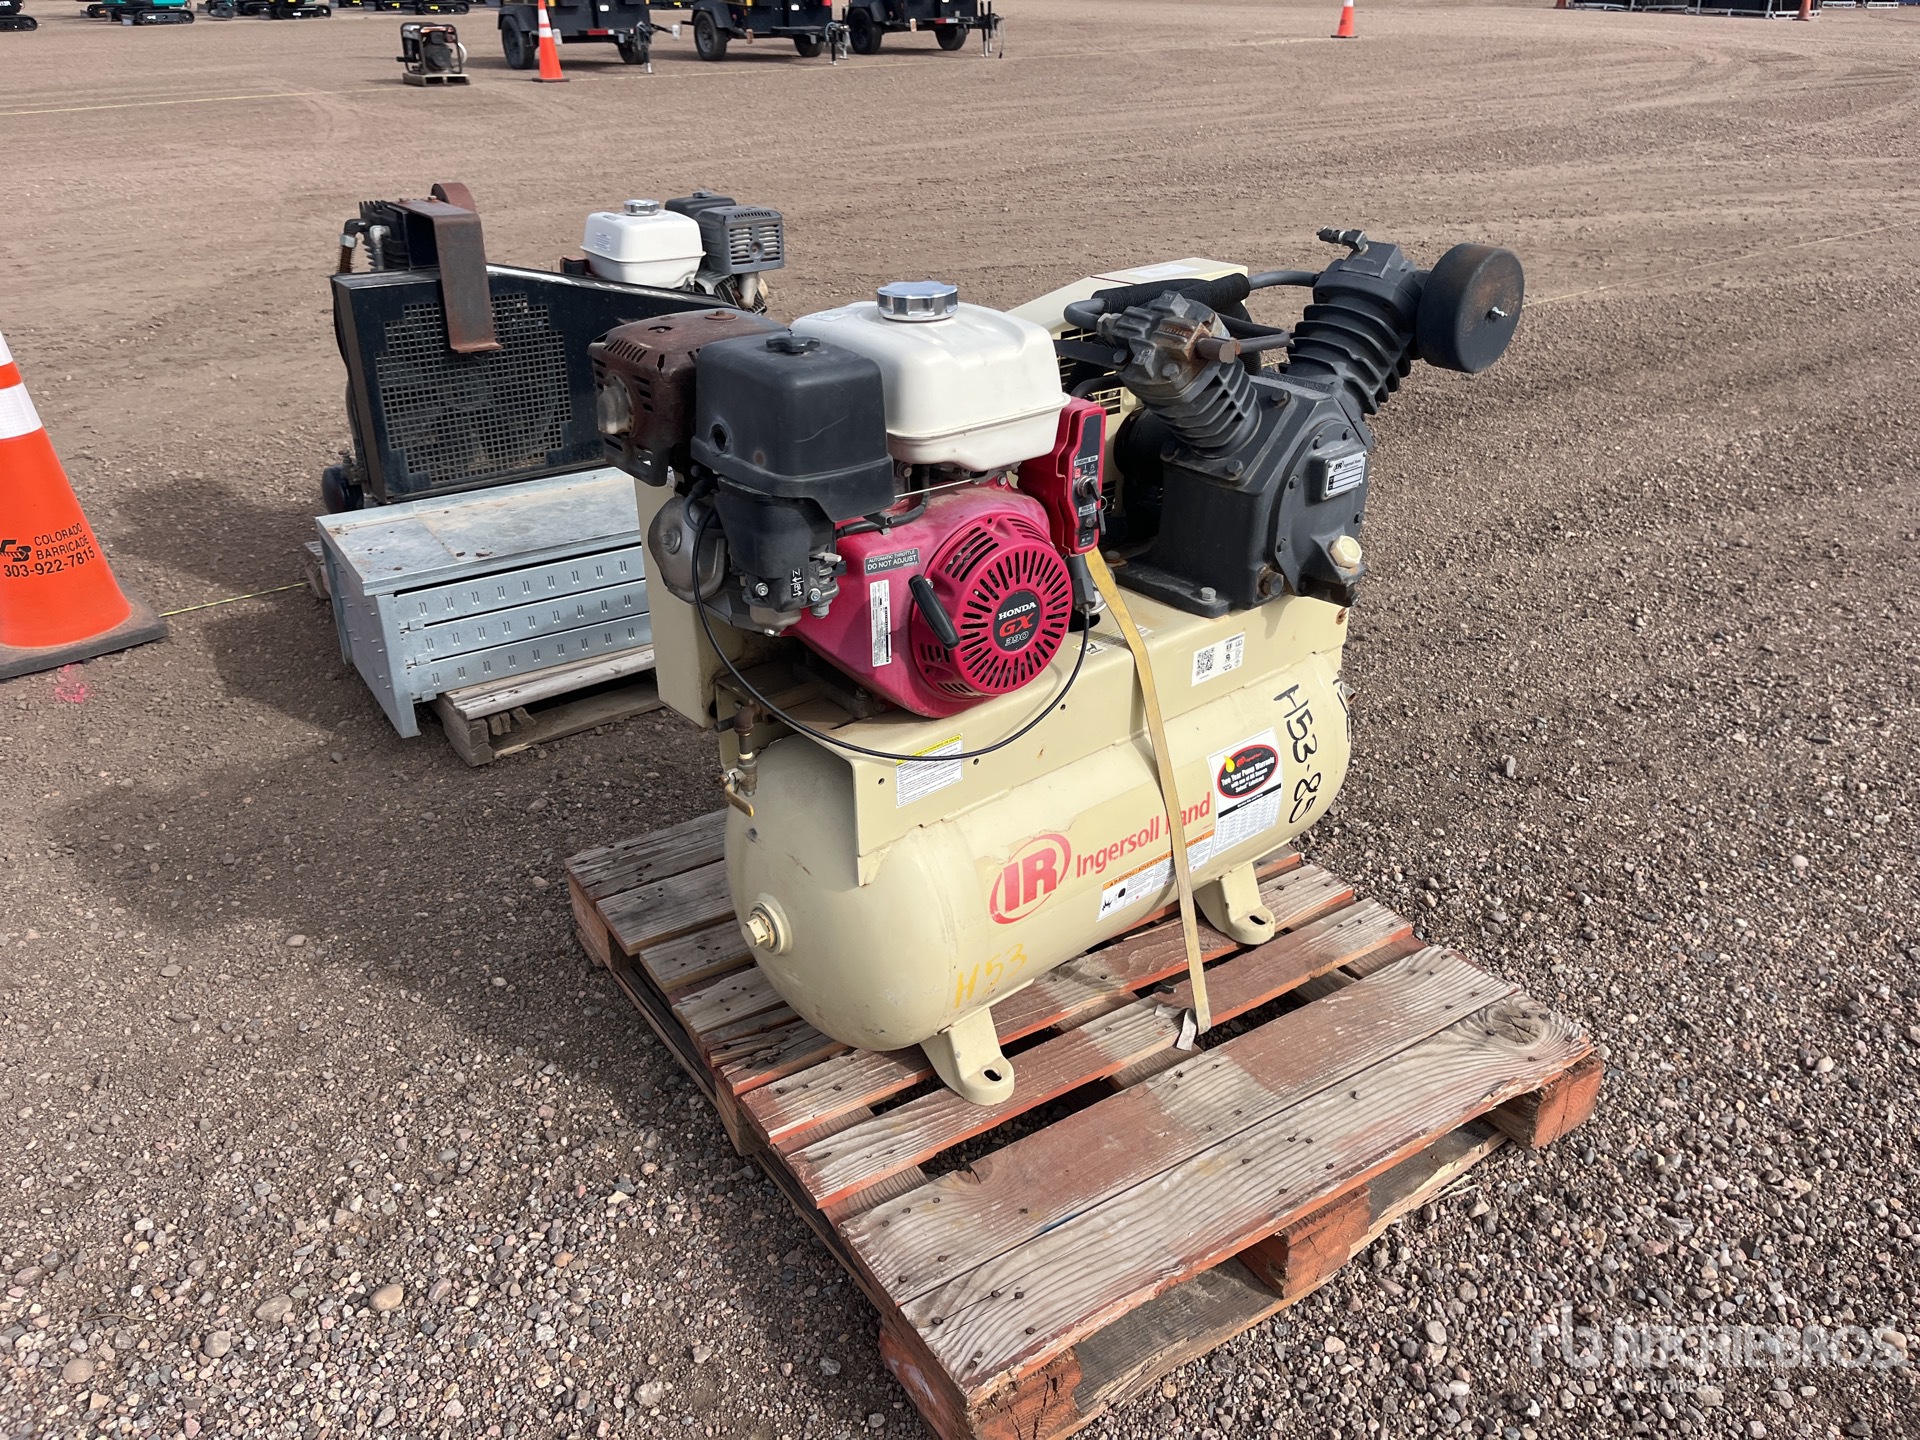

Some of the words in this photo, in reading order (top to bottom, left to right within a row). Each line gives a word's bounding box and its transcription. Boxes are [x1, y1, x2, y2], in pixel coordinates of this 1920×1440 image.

[34, 522, 83, 546] COLORADO
[36, 534, 90, 560] BARRICADE
[868, 554, 894, 563] AUTOMATIC
[894, 549, 915, 559] THROTTLE
[3, 546, 95, 577] 303-922-7815
[878, 559, 892, 568] NOT
[892, 554, 917, 566] ADJUST
[998, 601, 1037, 620] HONDA
[999, 612, 1035, 638] GX
[1004, 630, 1030, 647] 390
[1003, 847, 1058, 914] IR
[1076, 815, 1160, 879] Ingersoll
[954, 943, 1028, 1009] H53
